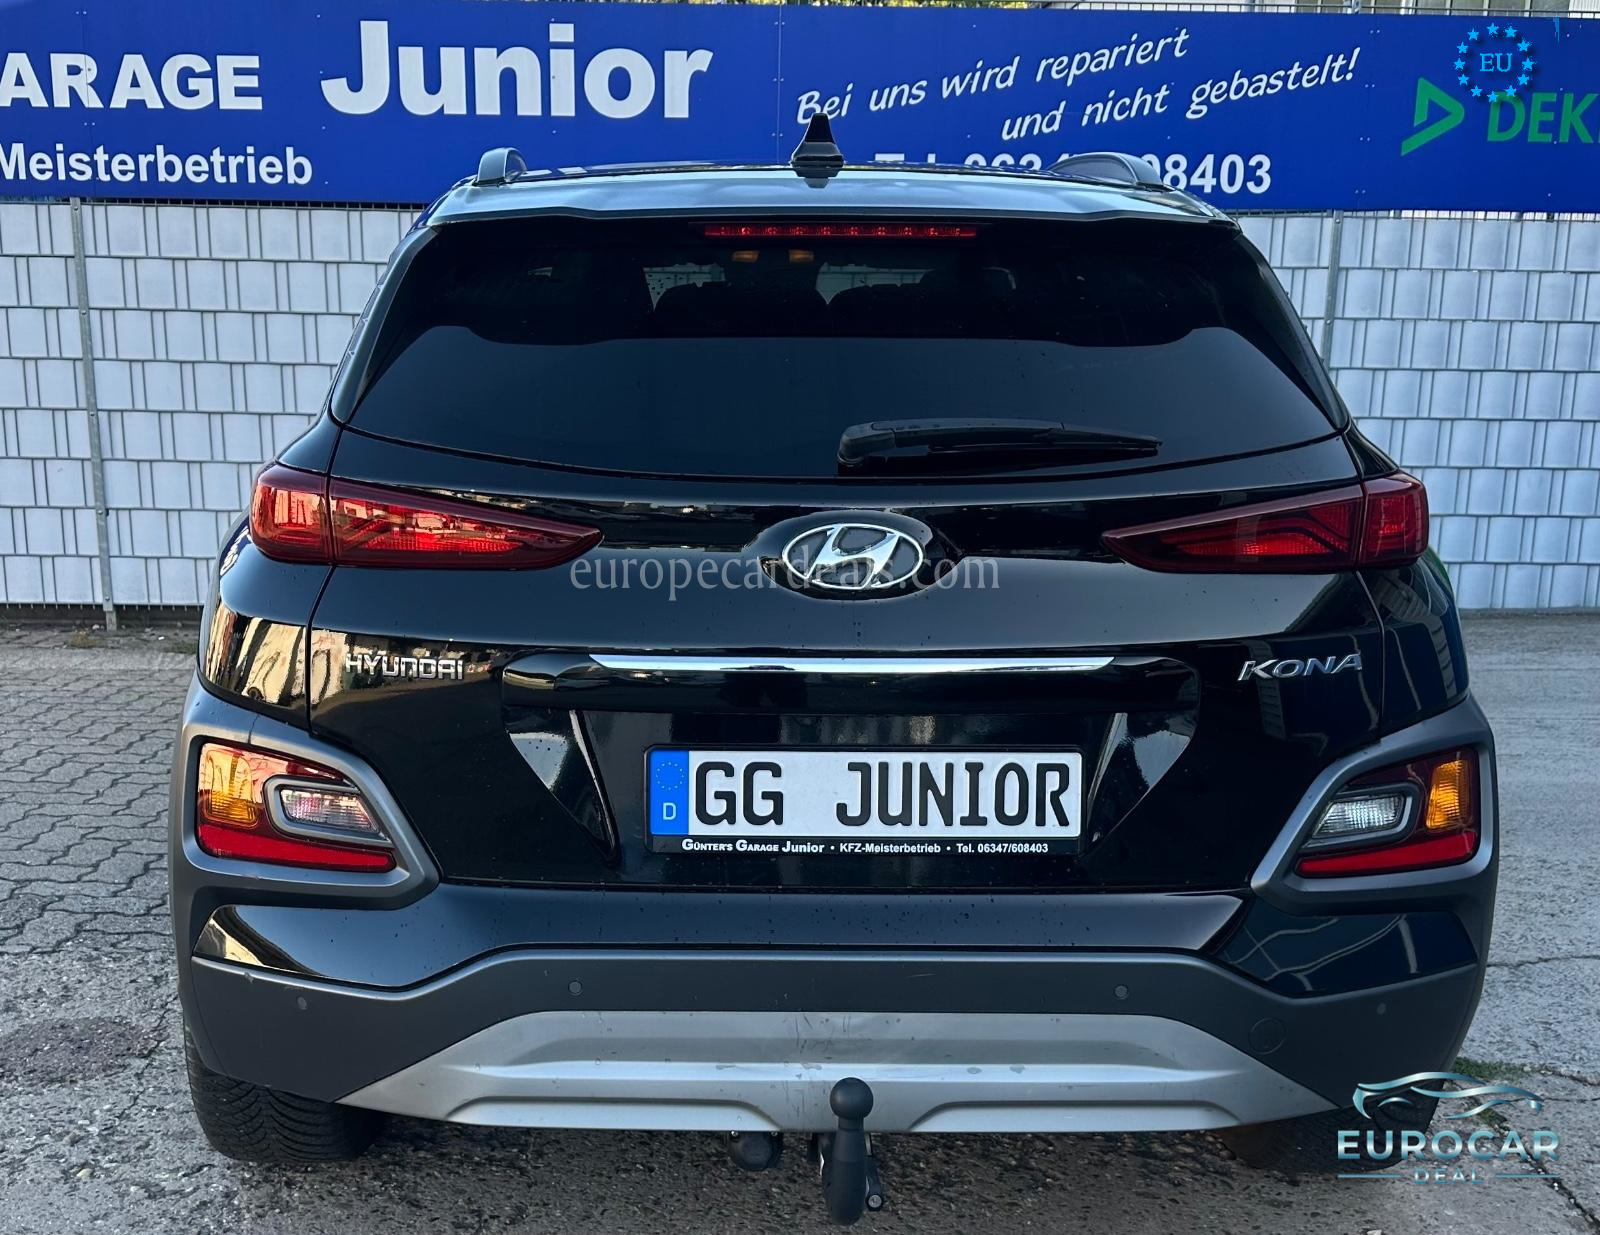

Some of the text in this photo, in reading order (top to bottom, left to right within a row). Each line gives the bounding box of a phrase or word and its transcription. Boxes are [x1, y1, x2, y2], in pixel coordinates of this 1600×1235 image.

[0, 20, 714, 119] ARAGE Junior
[796, 28, 1189, 124] Bei uns wird repariert
[1001, 47, 1361, 140] und nicht gebastelt!
[0, 142, 313, 185] Meisterbetrieb
[345, 652, 464, 680] HYUNDAI
[1237, 653, 1362, 681] KONA
[662, 761, 1070, 827] D GG JUNIOR
[781, 840, 825, 853] Junior
[839, 842, 941, 853] KFZ-Meisterbetrieb
[956, 843, 975, 853] Tel.
[977, 843, 1049, 854] 06347/608403
